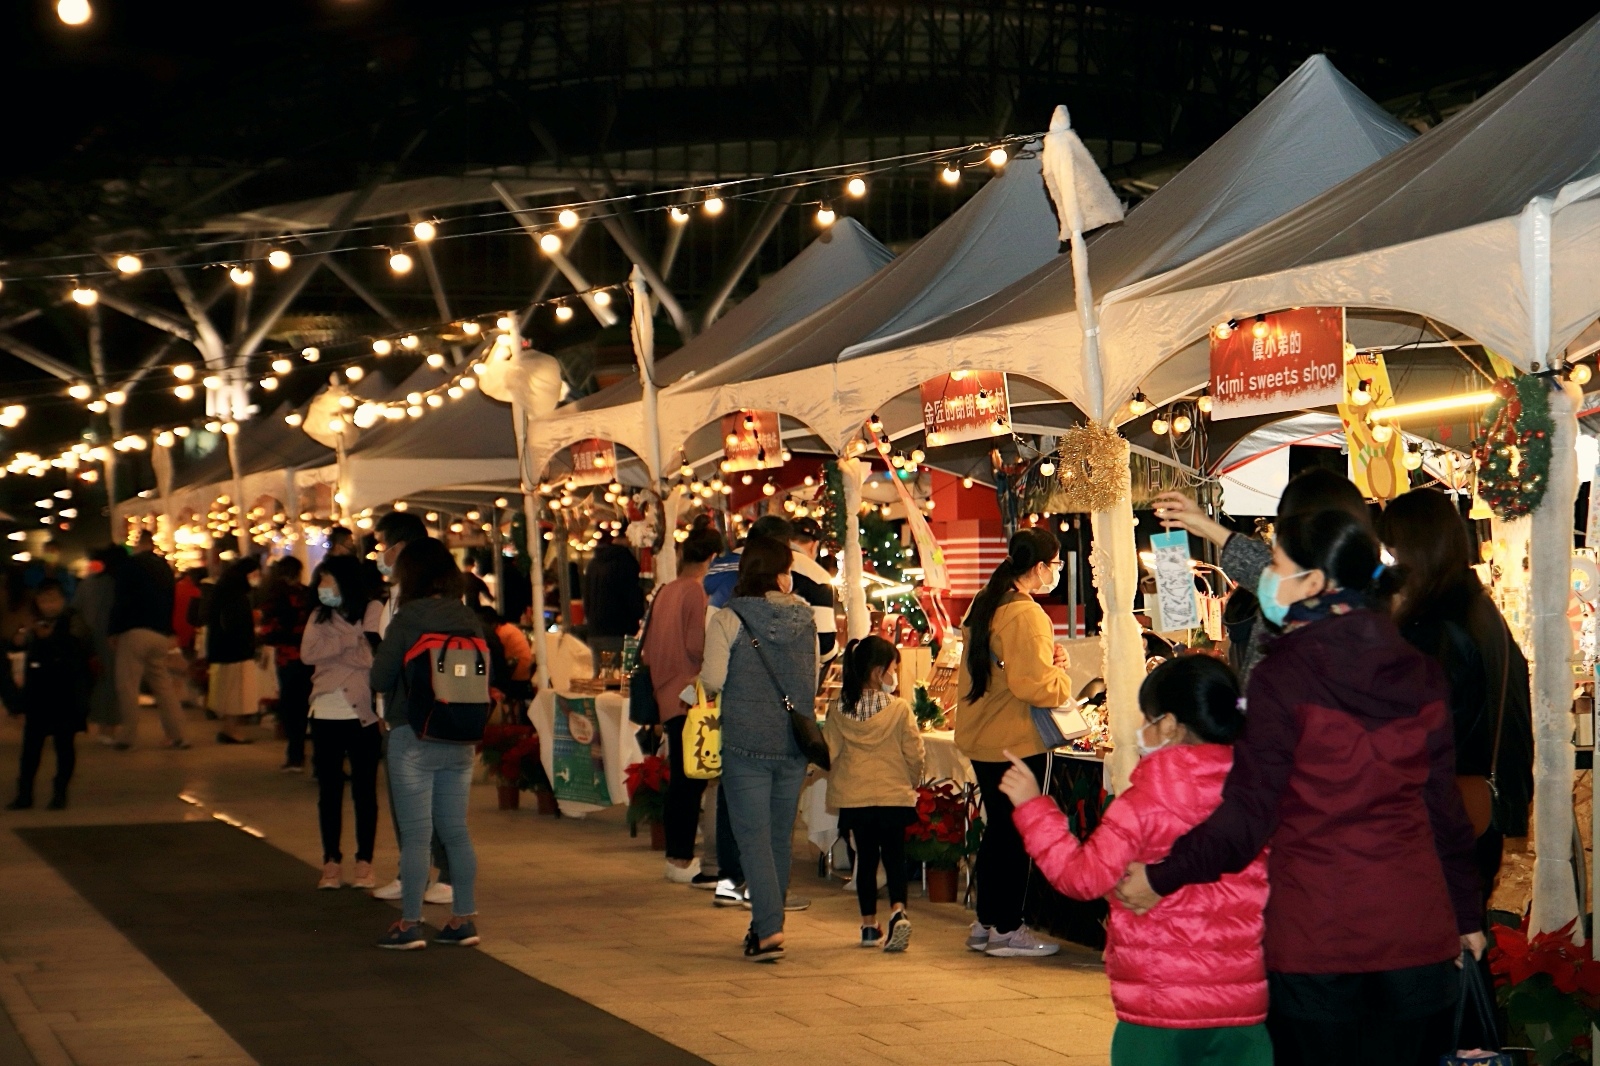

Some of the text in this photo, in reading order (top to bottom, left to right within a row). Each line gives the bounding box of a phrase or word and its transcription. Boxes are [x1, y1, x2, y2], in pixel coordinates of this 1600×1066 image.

[1216, 361, 1336, 396] kimi sweets shop
